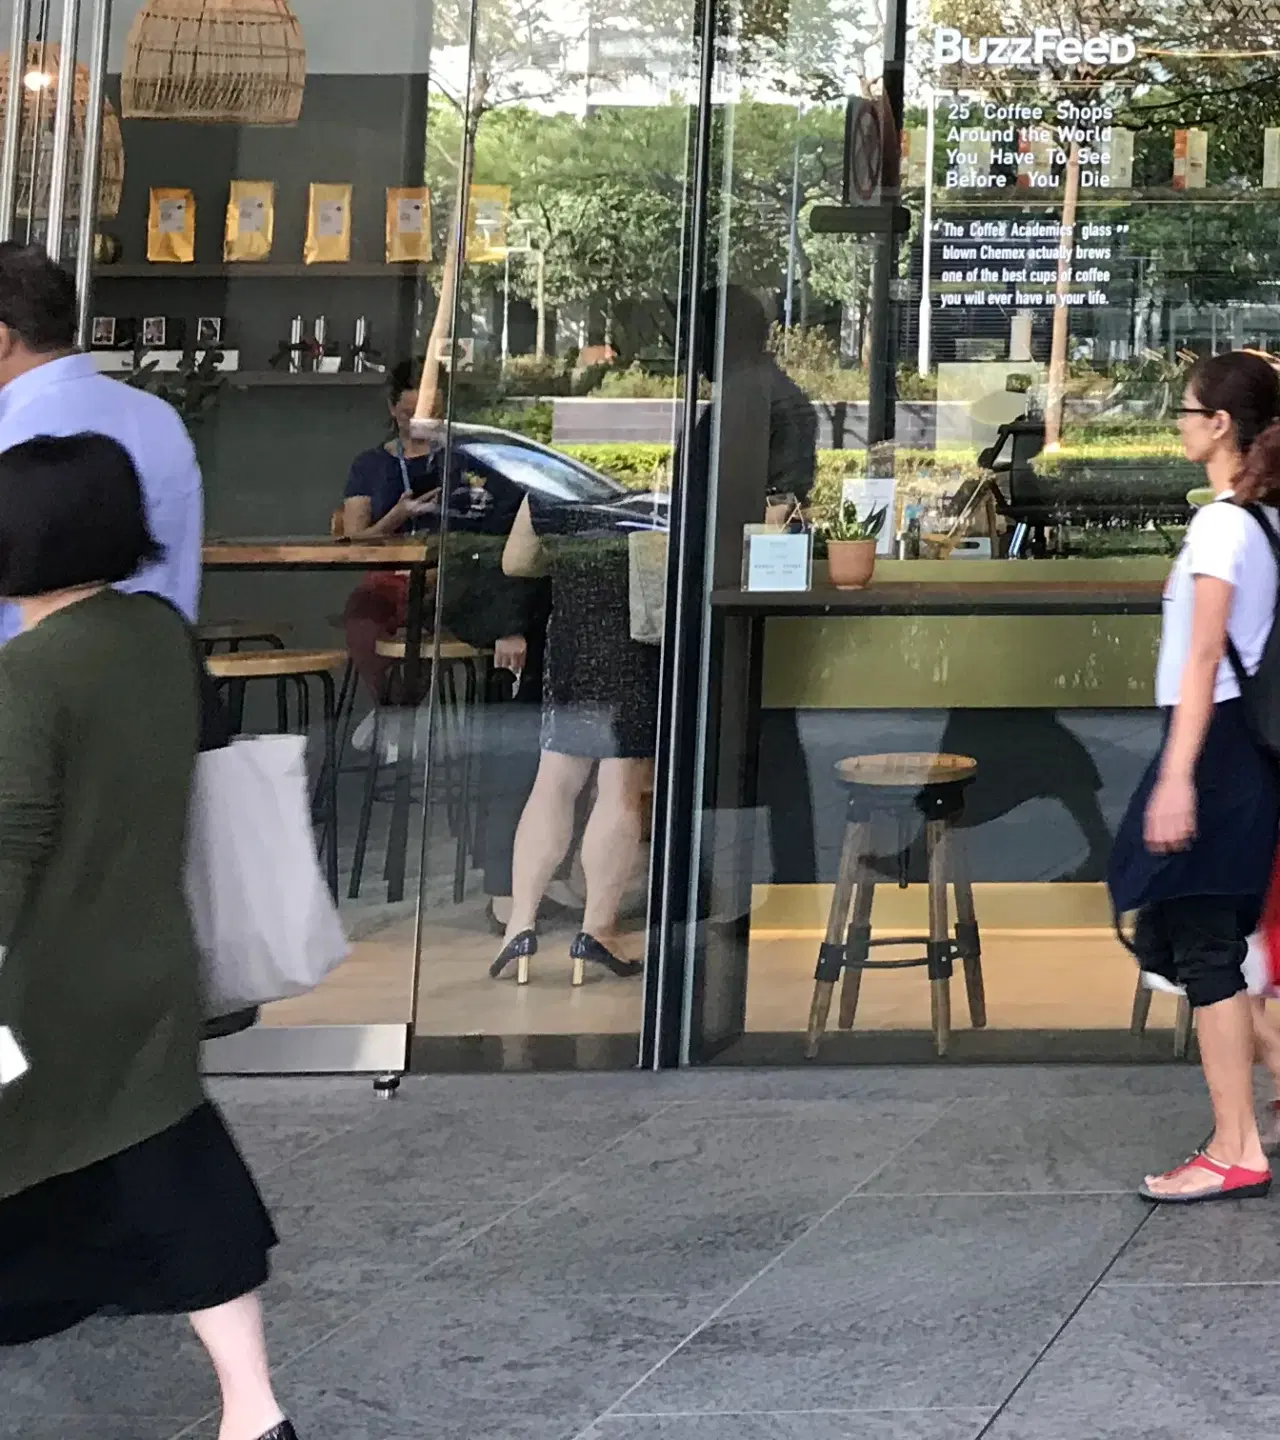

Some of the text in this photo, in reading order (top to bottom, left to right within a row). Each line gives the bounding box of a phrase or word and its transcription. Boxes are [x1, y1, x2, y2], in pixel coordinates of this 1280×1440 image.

[948, 104, 1113, 124] 25 Coffee Shops
[946, 127, 1112, 142] Around the World
[946, 149, 1111, 165] You Have To See
[946, 172, 1110, 188] Before You Die
[970, 222, 1006, 237] Coffee
[943, 245, 1111, 262] blown Chemex actually brews
[942, 267, 1110, 285] one of the best cups of coffee
[941, 291, 1109, 308] you will ever have in your life.
